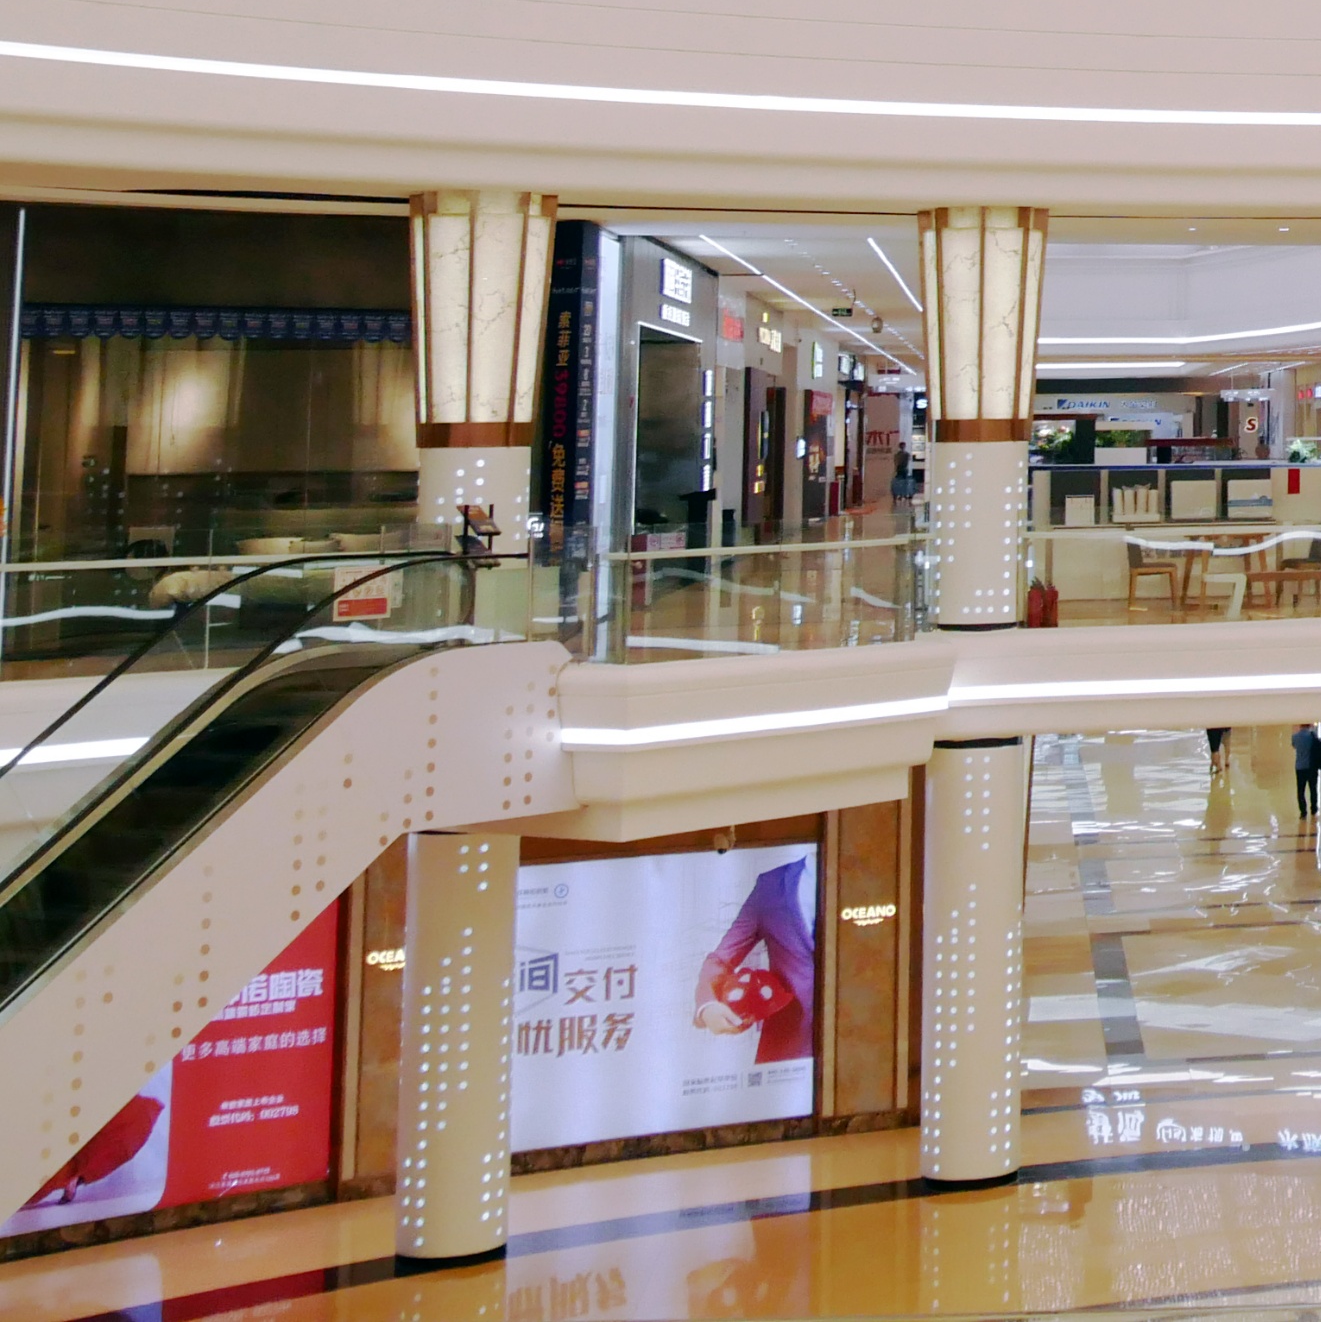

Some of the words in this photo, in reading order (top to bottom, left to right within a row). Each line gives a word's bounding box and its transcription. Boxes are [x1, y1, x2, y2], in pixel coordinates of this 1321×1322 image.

[1067, 400, 1111, 409] DAIKIN
[841, 904, 897, 920] OCEANO
[181, 1026, 327, 1063] 更多高端家庭的选择
